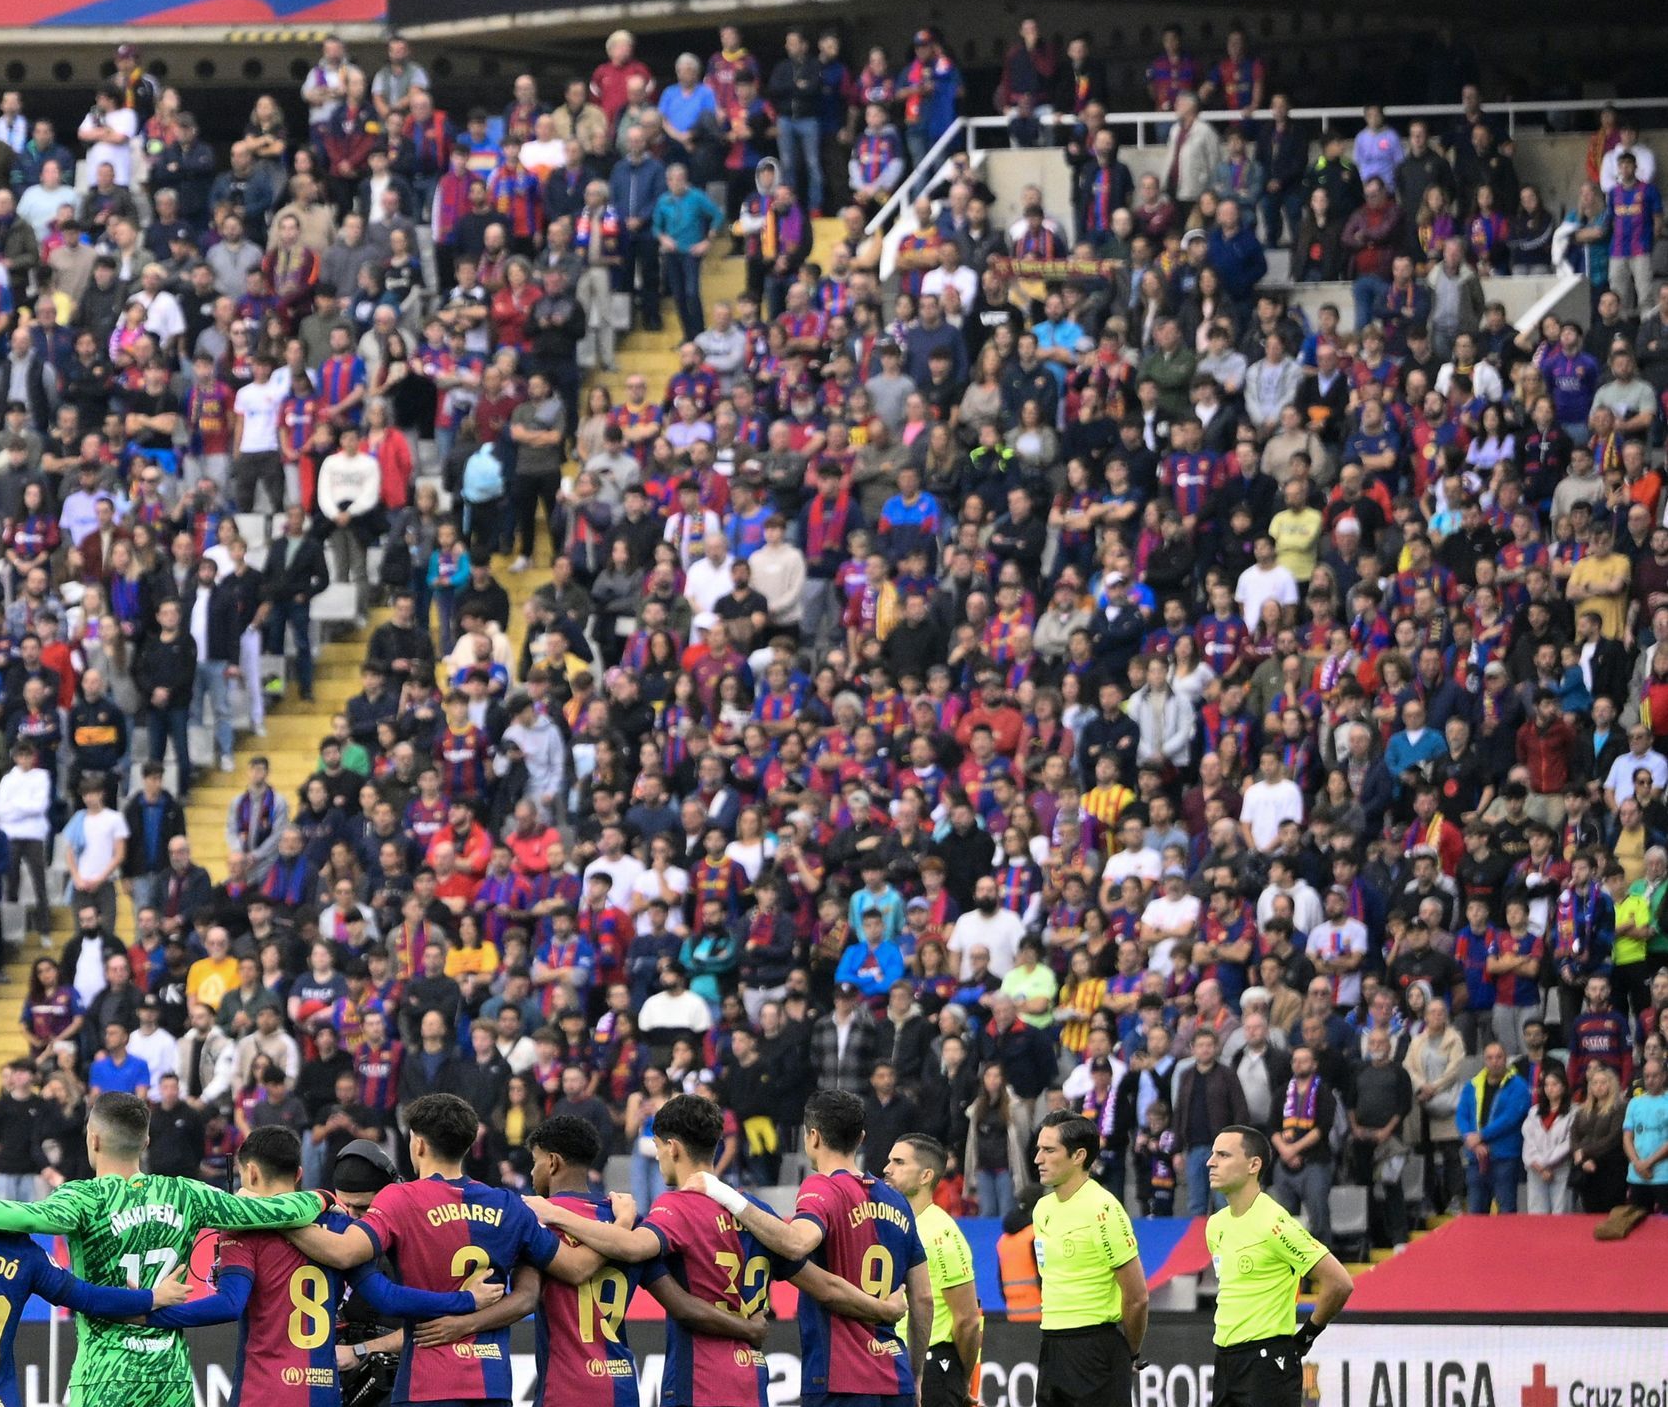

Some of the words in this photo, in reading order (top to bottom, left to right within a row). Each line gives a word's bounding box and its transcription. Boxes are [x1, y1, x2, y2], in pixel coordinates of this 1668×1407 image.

[578, 1266, 629, 1343] 19
[860, 1244, 894, 1301] 9
[288, 1265, 331, 1350] 8
[1569, 1380, 1623, 1407] Cruz
